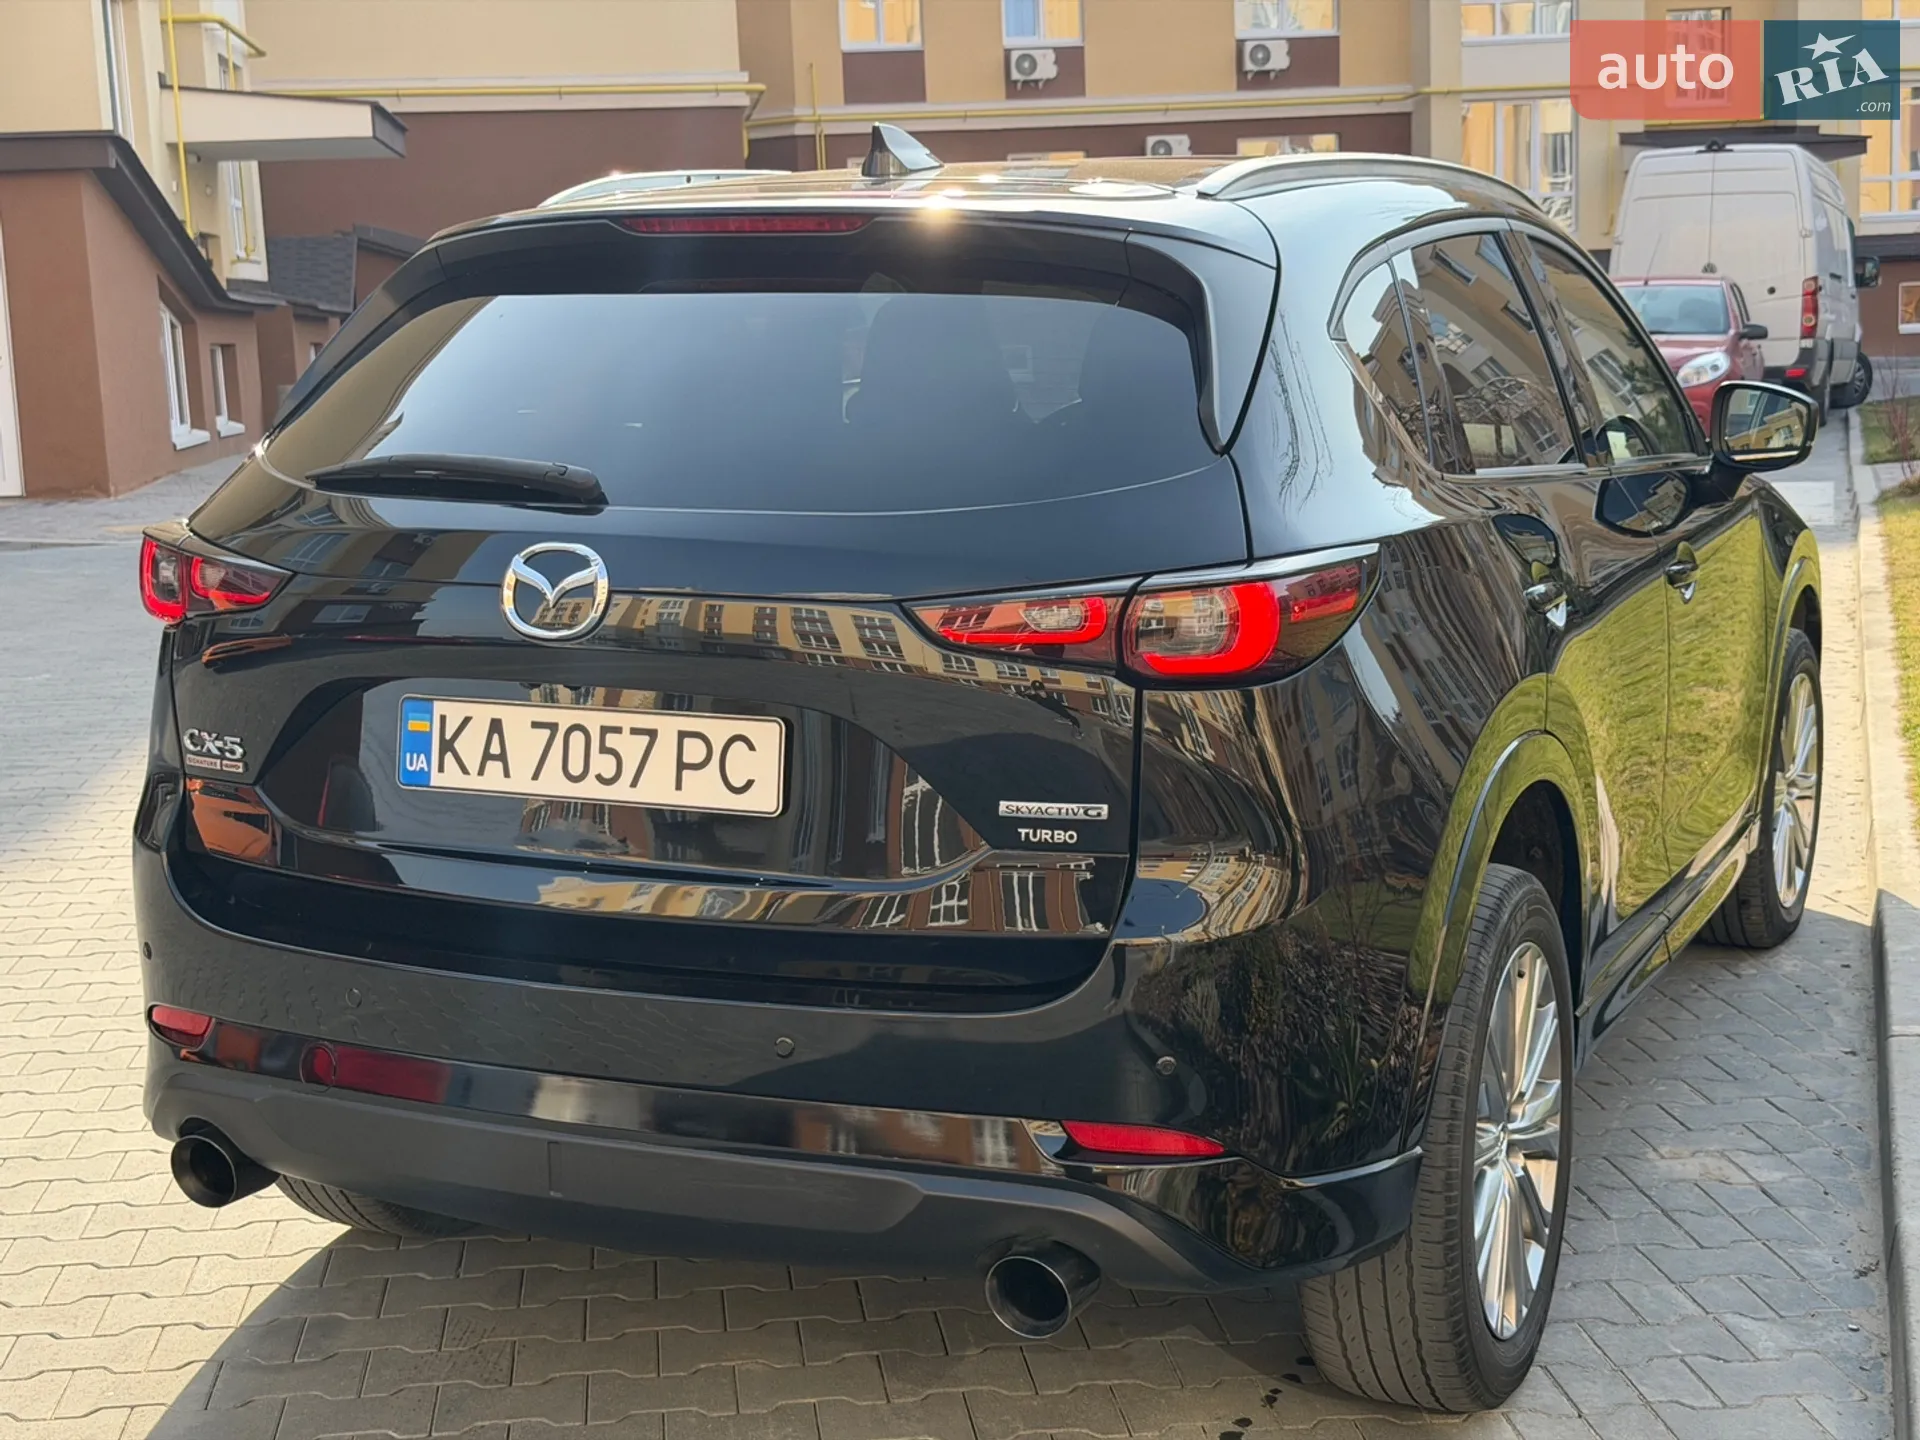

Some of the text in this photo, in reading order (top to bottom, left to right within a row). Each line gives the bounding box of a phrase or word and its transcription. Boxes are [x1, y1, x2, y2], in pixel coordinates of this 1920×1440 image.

[183, 728, 244, 759] CX-5
[437, 714, 757, 795] KA 7057 PC
[405, 753, 428, 772] UA
[1017, 828, 1077, 844] TURBO
